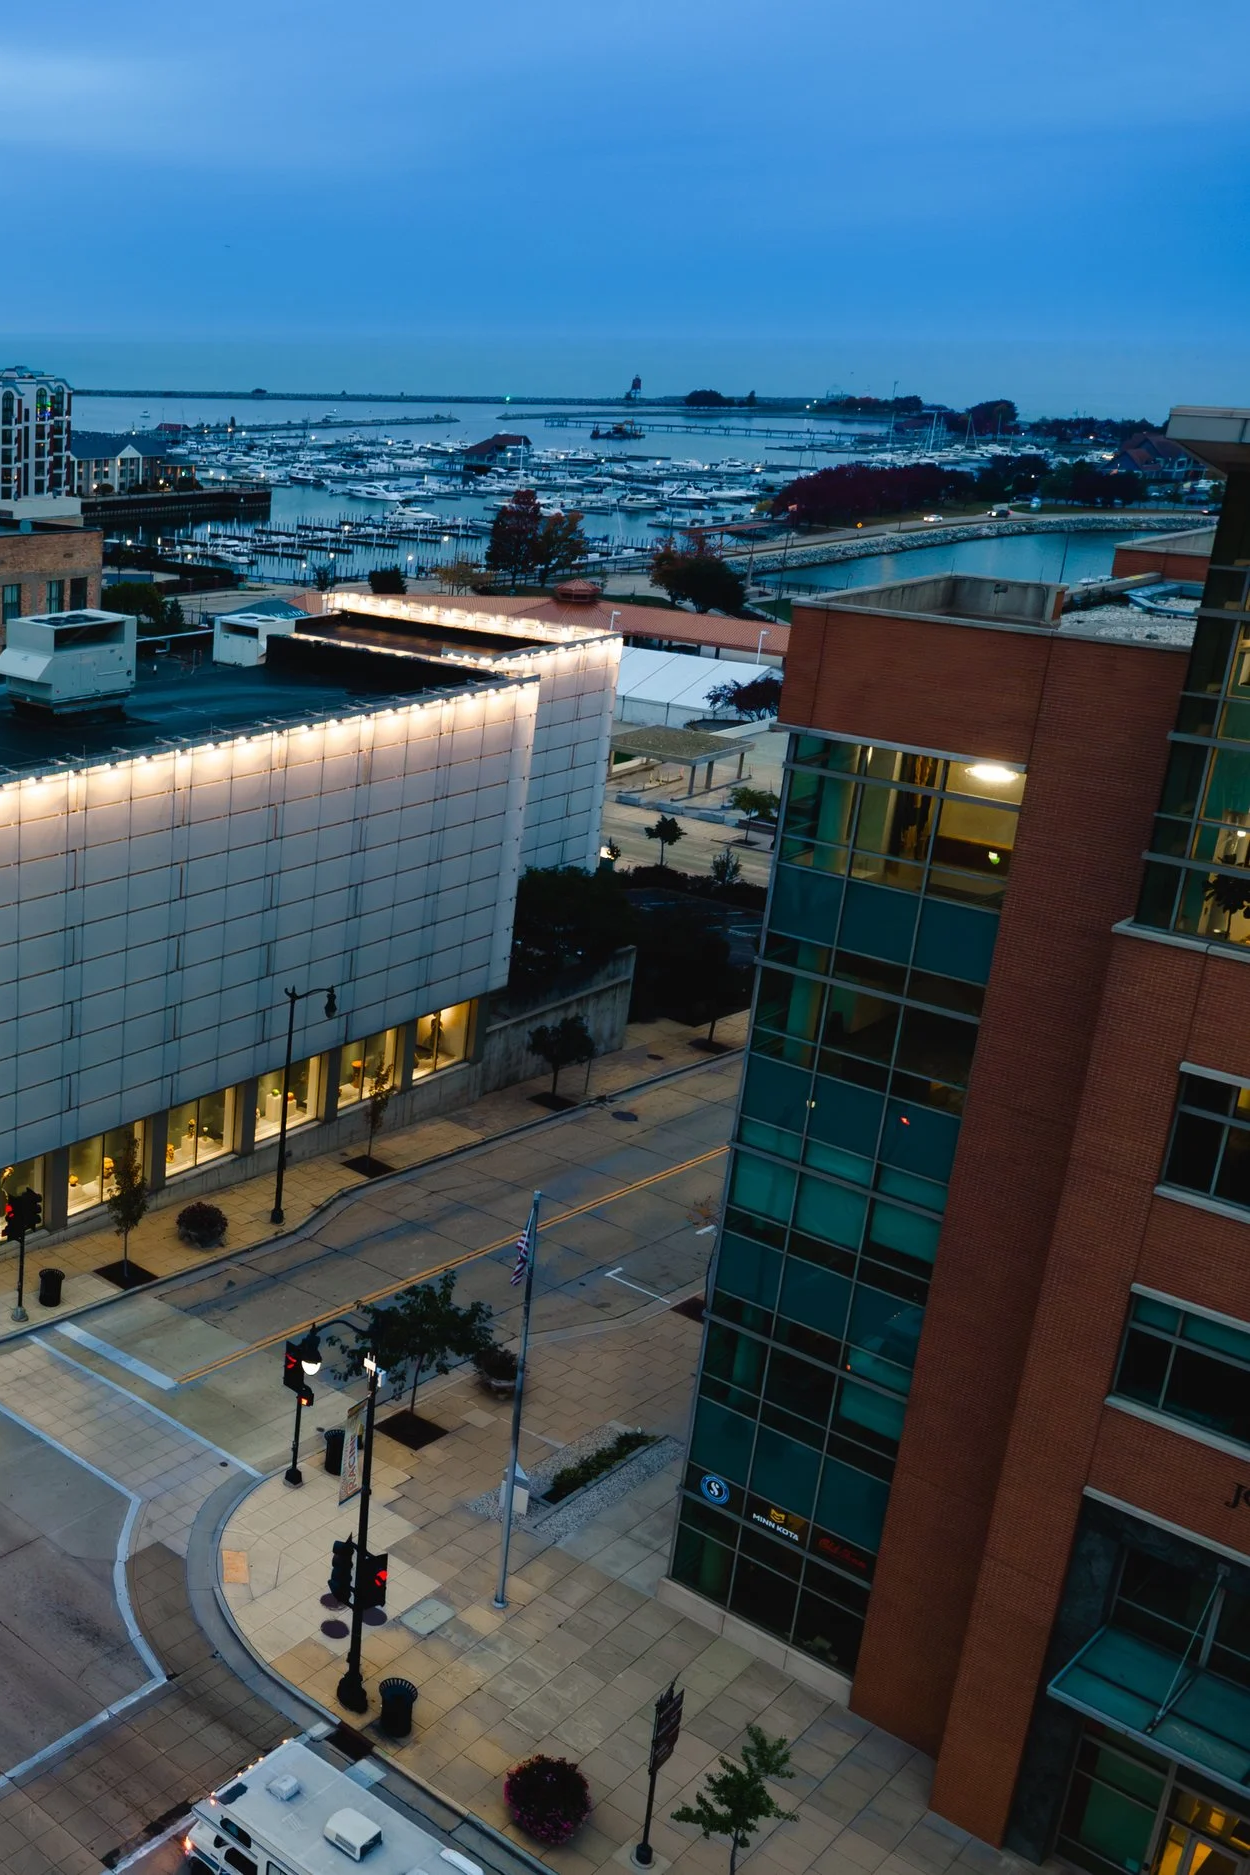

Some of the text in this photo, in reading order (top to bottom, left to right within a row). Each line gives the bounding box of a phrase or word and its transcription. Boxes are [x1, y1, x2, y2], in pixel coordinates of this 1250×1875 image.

[347, 1435, 360, 1494] RACINE
[752, 1512, 799, 1542] MINN KOTA
